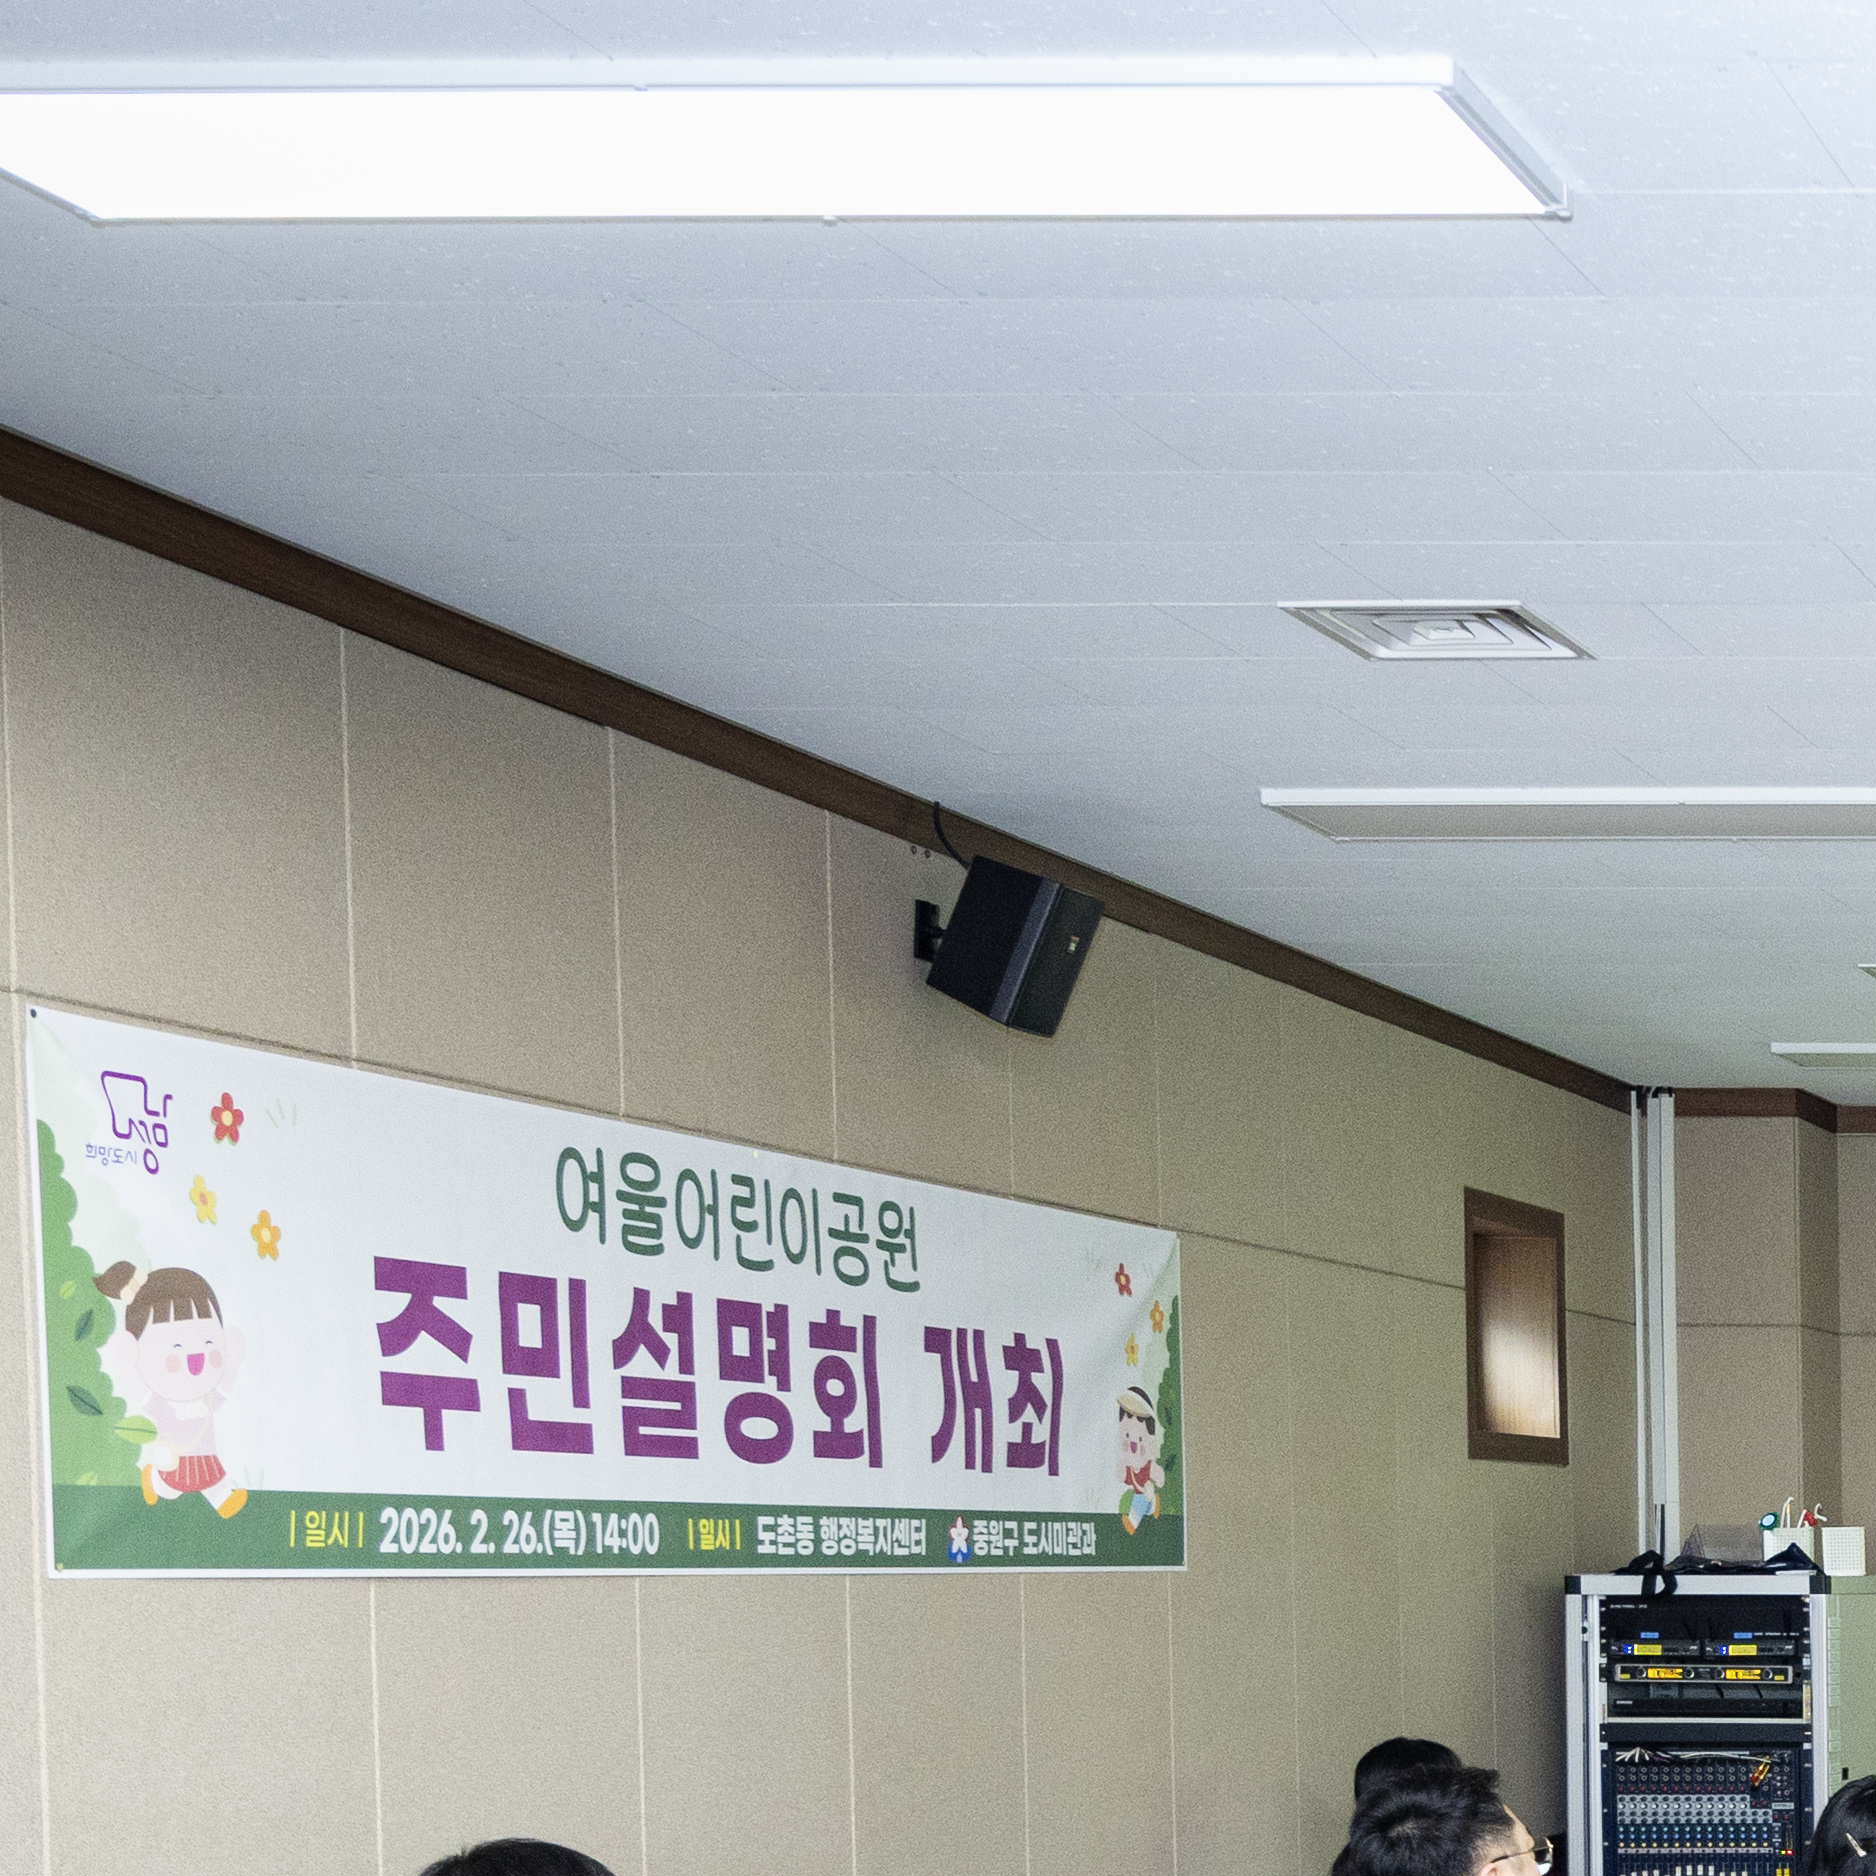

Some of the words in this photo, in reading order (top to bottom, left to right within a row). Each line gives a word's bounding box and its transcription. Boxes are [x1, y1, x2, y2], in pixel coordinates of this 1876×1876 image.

[85, 1142, 138, 1166] 희망도시
[556, 1146, 921, 1293] 여울어린이공원
[373, 1256, 883, 1469] 주민설명회
[923, 1325, 1064, 1477] 개최
[305, 1510, 349, 1548] 일시
[379, 1507, 463, 1554] 2026.
[470, 1508, 495, 1554] 2.
[592, 1512, 660, 1555] 14:00
[699, 1517, 730, 1550] 일시
[756, 1515, 815, 1556] 도촌동
[819, 1516, 926, 1557] 행정복지센터
[972, 1519, 1019, 1557] 중원구
[1022, 1520, 1097, 1557] 도시미관과
